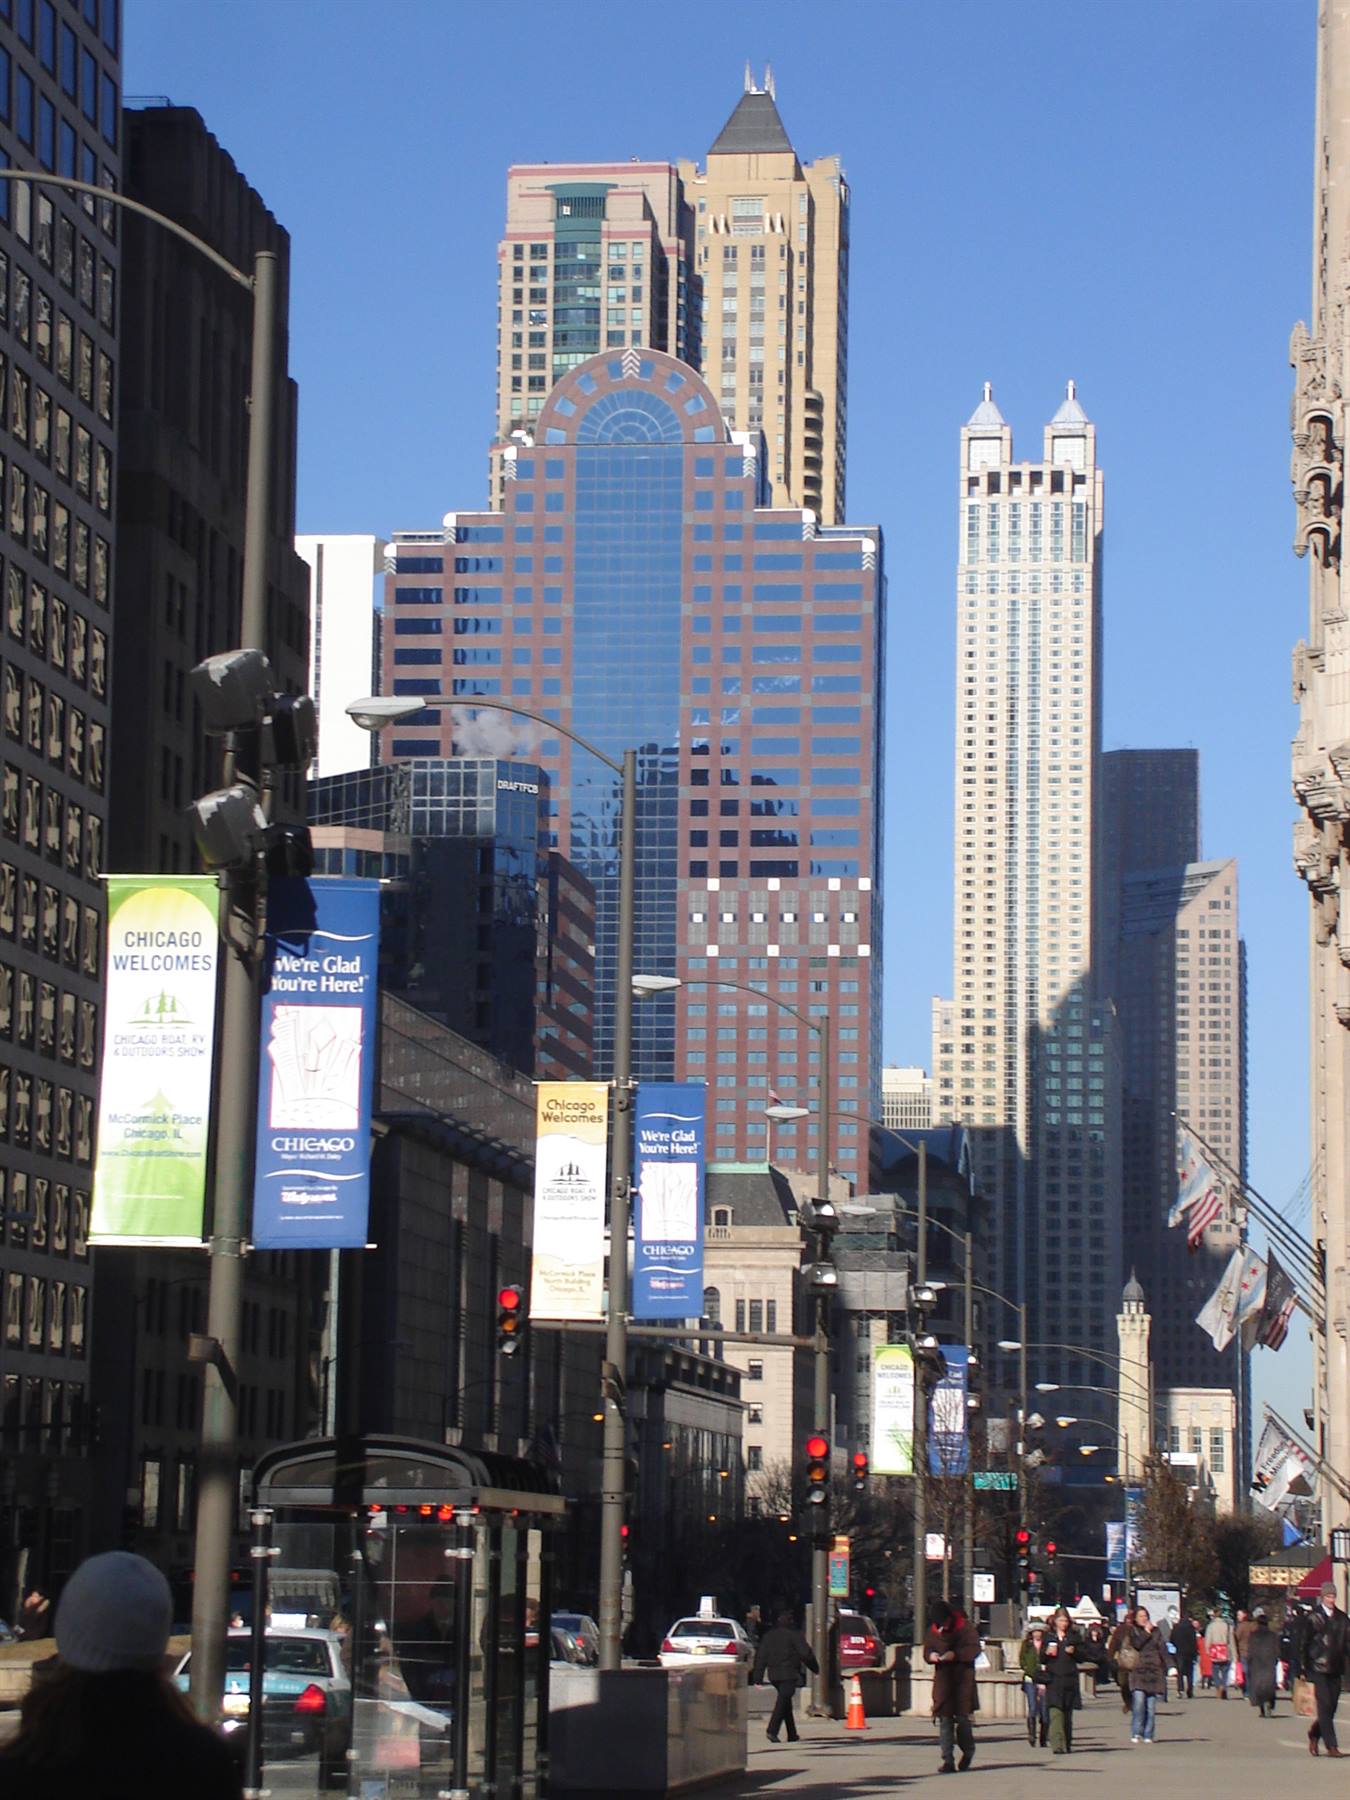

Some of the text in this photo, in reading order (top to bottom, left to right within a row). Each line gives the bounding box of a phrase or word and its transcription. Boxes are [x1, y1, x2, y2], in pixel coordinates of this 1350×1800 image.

[497, 779, 538, 794] DRAFTFCB
[124, 931, 202, 948] CHICAGO
[112, 954, 212, 971] WELCOMES
[274, 955, 360, 974] We're Glad
[271, 975, 364, 993] You're Here!
[113, 1034, 158, 1045] CHICAGO
[192, 1034, 206, 1044] RV
[121, 1046, 176, 1057] OUTDOORS
[177, 1046, 206, 1057] SHOW
[546, 1099, 596, 1114] Chicago
[107, 1113, 202, 1125] McCormick Place
[541, 1111, 604, 1123] Welcomes
[173, 1129, 183, 1139] IL
[641, 1129, 696, 1142] We're Glad
[271, 1137, 355, 1152] CHICAGO
[639, 1142, 698, 1154] You're Here!
[642, 1245, 695, 1256] CHICAGO
